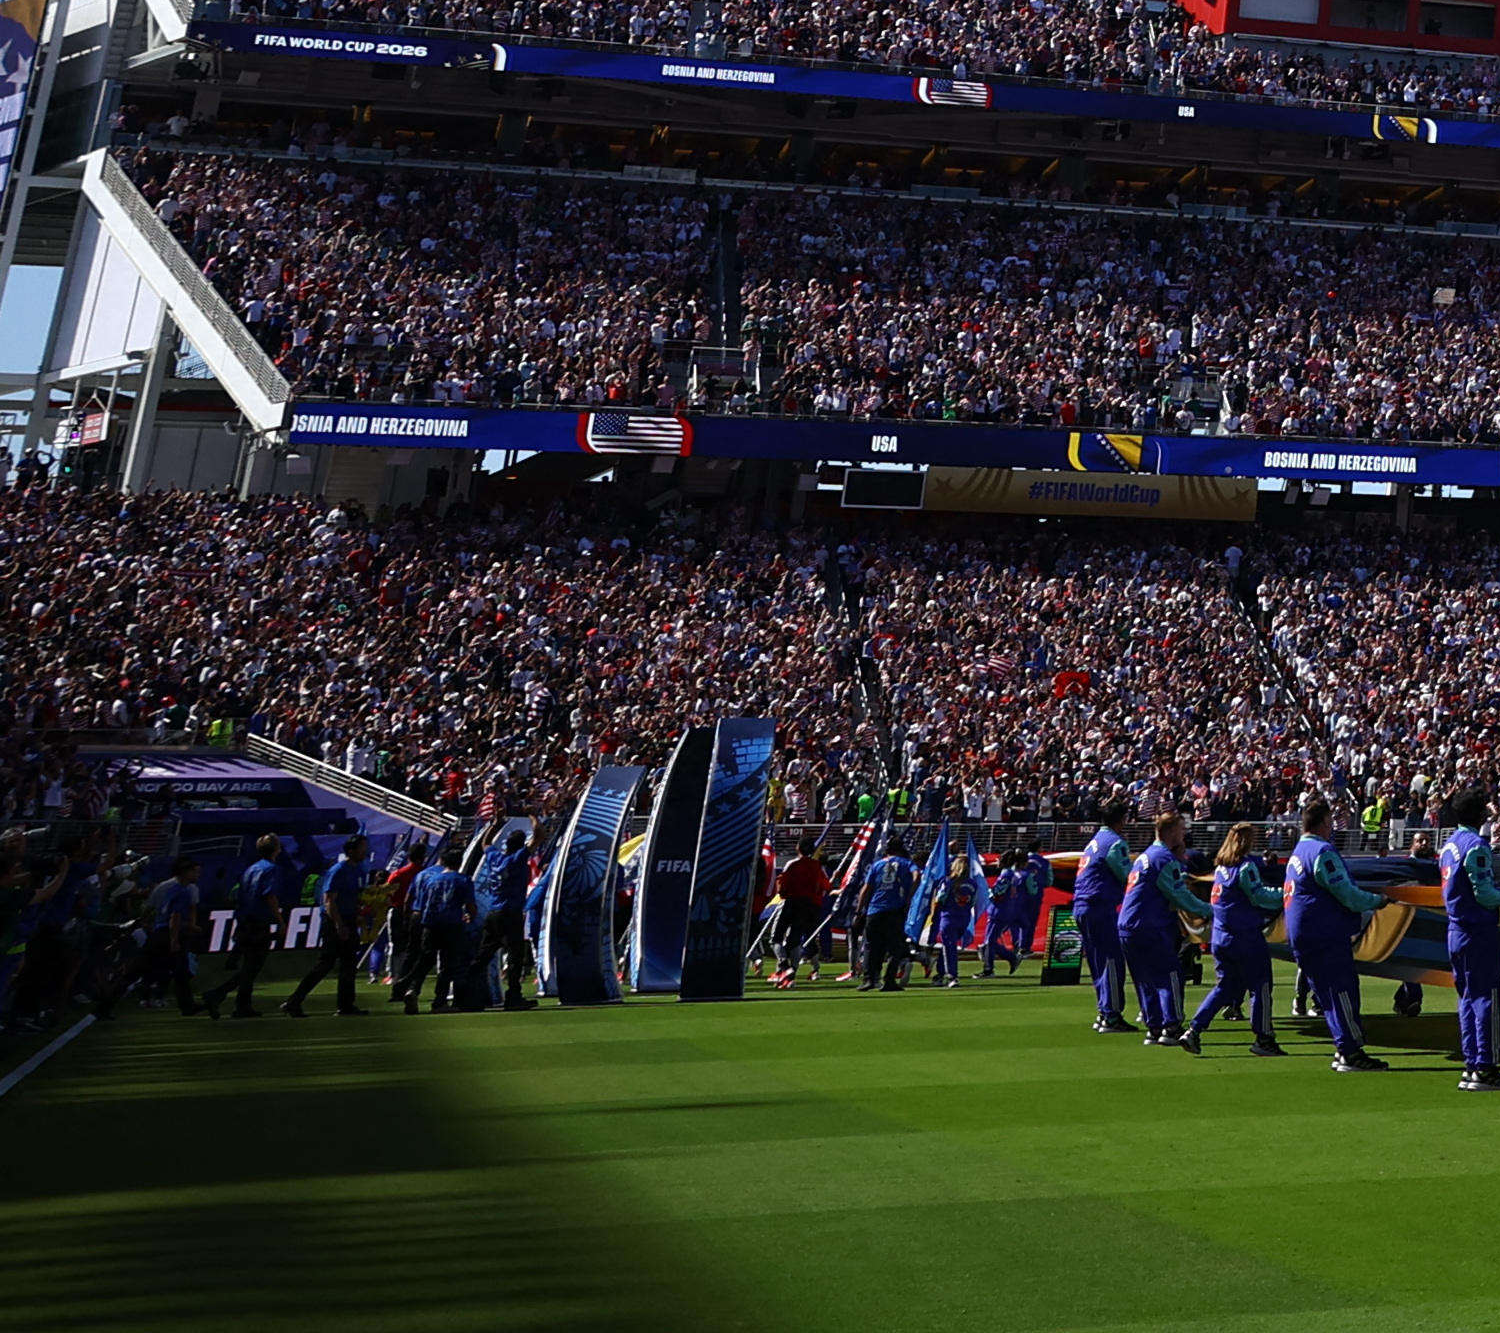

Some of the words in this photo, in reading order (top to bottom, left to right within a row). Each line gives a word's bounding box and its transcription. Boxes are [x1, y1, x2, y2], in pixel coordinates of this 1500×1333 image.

[255, 35, 286, 46] FIFA
[290, 37, 342, 50] WORLD
[345, 41, 374, 52] CUP
[376, 44, 427, 56] 2026
[662, 65, 695, 77] BOSNIA
[697, 67, 715, 78] AND
[716, 69, 774, 83] HERZEGOVINA
[1178, 106, 1194, 117] USA
[336, 416, 367, 433] AND
[370, 417, 468, 436] HERZEGOVINA
[872, 436, 897, 452] USA
[1265, 452, 1308, 468] BOSNIA
[1311, 454, 1336, 469] AND
[1338, 455, 1416, 472] HERZEGOVINA
[1028, 482, 1161, 507] #FIFAWorldCup
[195, 783, 227, 792] BAY
[229, 783, 272, 793] AREA
[657, 860, 692, 873] FIFA
